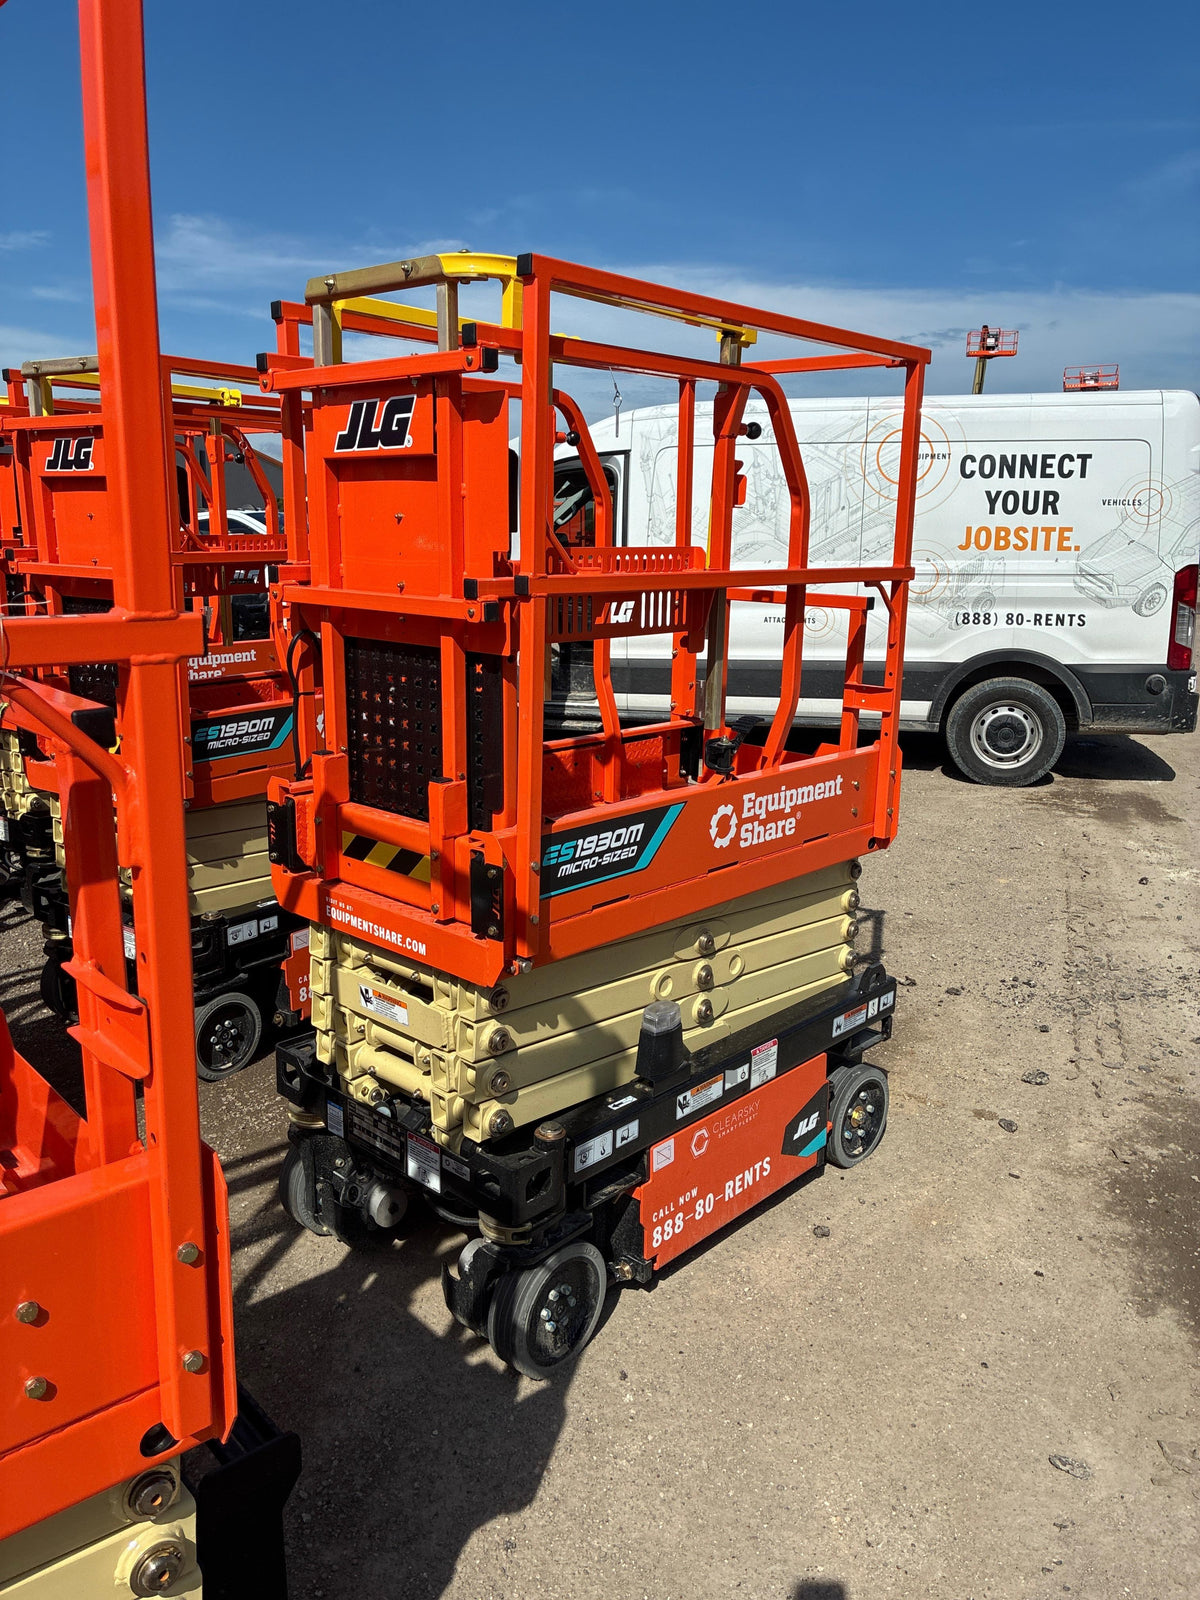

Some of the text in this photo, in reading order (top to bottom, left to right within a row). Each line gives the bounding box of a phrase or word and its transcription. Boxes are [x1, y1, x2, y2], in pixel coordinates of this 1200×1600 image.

[45, 436, 94, 471] JLG
[959, 454, 1092, 479] CONNECT
[985, 490, 1060, 515] YOUR
[957, 526, 1082, 552] JOBSITE.
[955, 612, 1087, 627] (888) 80-RENTS
[187, 649, 256, 669] quipment
[188, 667, 223, 680] hare
[194, 717, 275, 742] ES1930M
[207, 732, 271, 750] MICRO-SIZED
[742, 775, 843, 820] Equipment
[542, 823, 645, 866] ES1930M
[557, 846, 638, 878] MICRO-SIZED
[326, 905, 427, 956] EQUIPMENTSHARE.COM
[713, 1099, 761, 1134] CLEARSKY
[793, 1111, 820, 1140] JLG
[652, 1157, 771, 1248] 888-80-RENTS
[653, 1187, 698, 1222] CALL NOW
